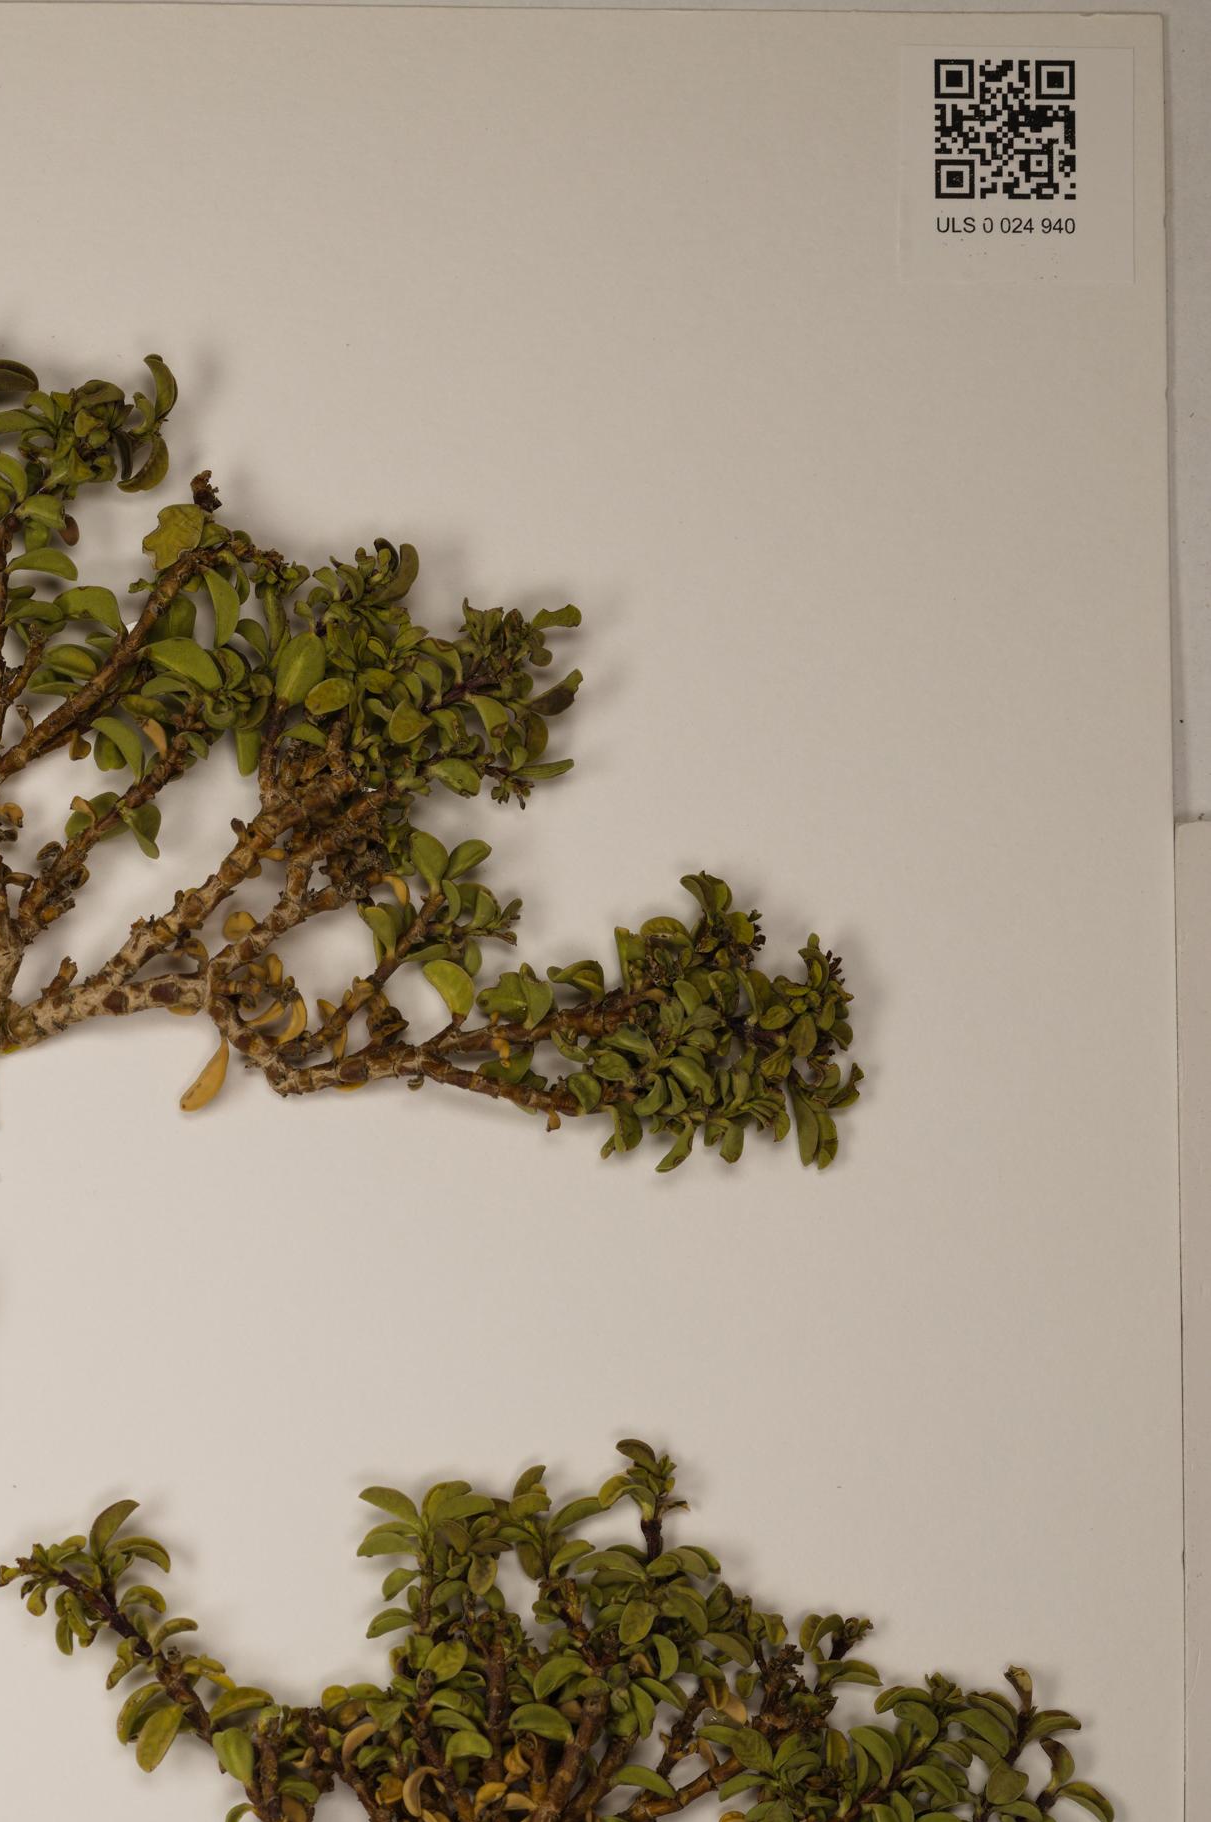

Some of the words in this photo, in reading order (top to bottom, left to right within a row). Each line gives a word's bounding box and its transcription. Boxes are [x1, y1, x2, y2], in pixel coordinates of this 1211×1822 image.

[936, 216, 976, 234] ULS
[982, 216, 994, 234] 0
[1000, 217, 1035, 235] 024
[1041, 217, 1076, 235] 940
